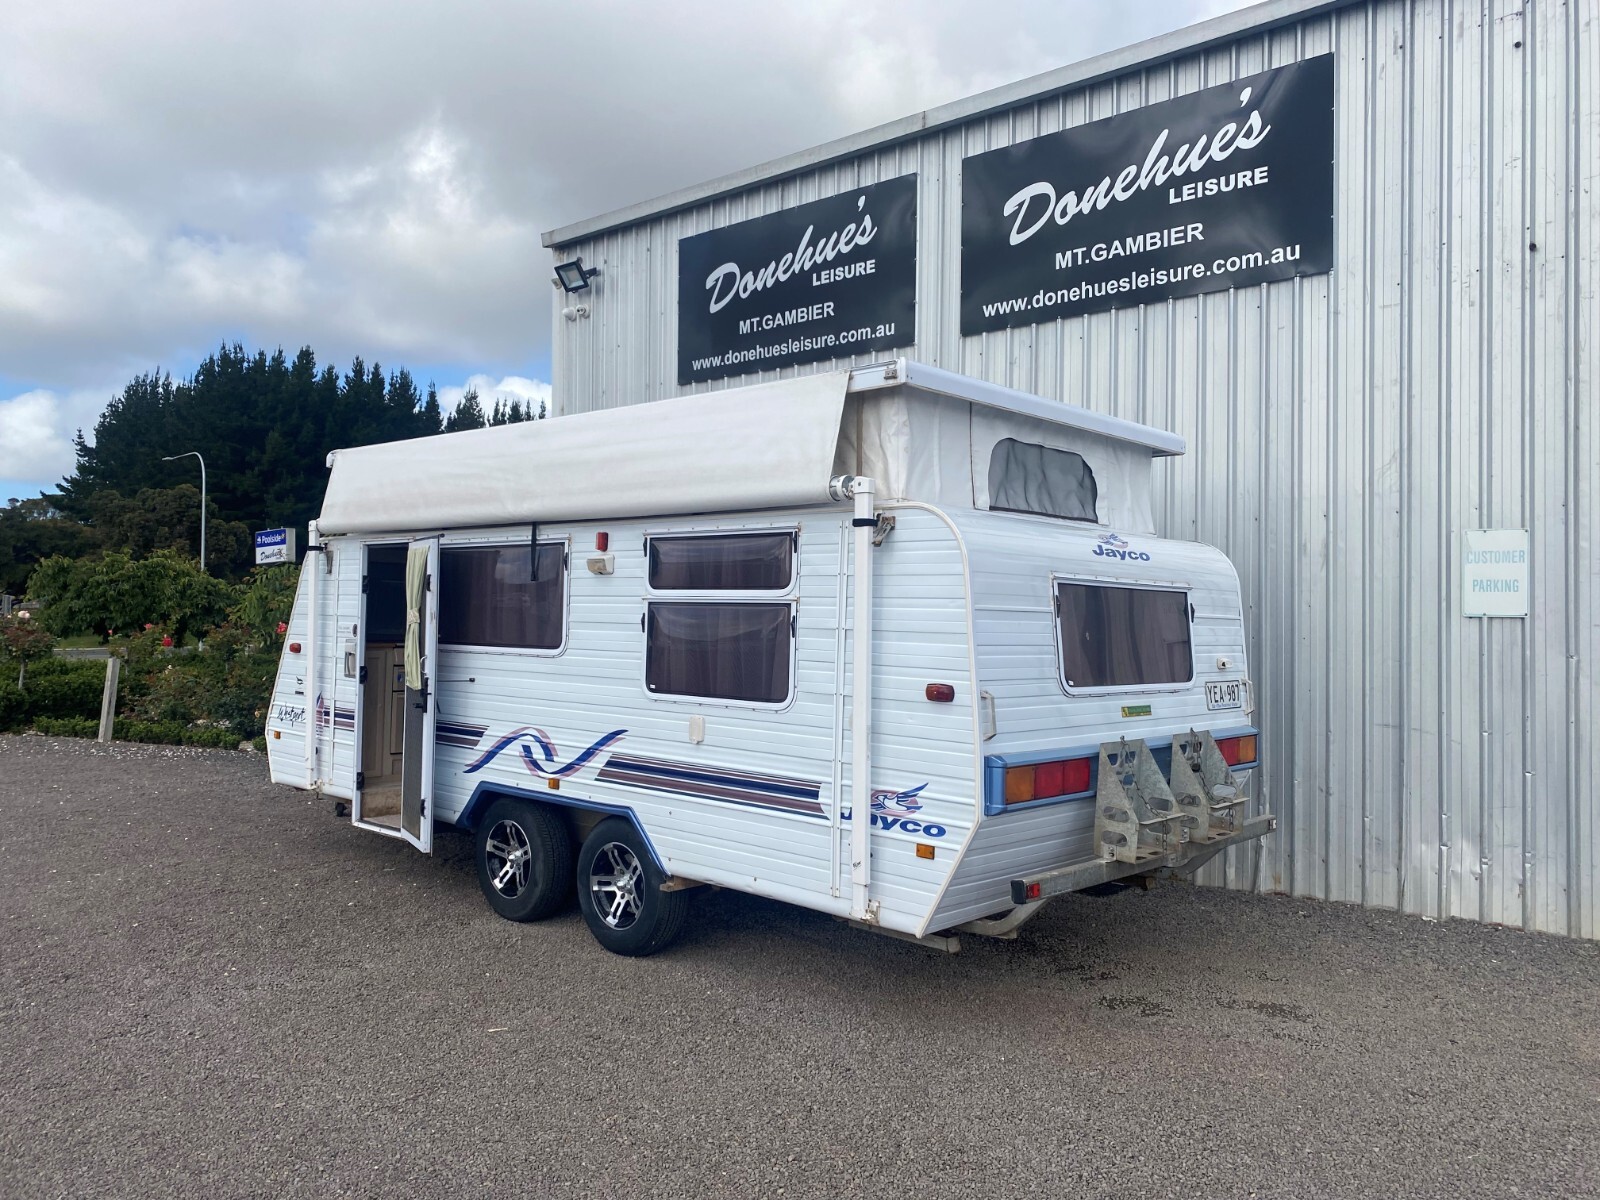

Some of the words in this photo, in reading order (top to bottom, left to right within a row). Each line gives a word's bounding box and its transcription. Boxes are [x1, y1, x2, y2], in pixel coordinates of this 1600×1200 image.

[1003, 86, 1271, 246] Donehue's
[1168, 166, 1269, 205] LEISURE
[705, 195, 878, 314] Donehue's
[1055, 222, 1204, 270] MT.GAMBIER
[812, 259, 876, 287] LEISURE
[982, 244, 1301, 318] www.donehuesleisure.com.au
[739, 301, 835, 335] MT.GAMBIER
[692, 322, 896, 371] www.donehuesleisure.com.au
[261, 533, 282, 544] Poolside
[1092, 544, 1151, 562] Jayco
[1466, 549, 1526, 565] CUSTOMER
[1472, 578, 1520, 593] PARKING
